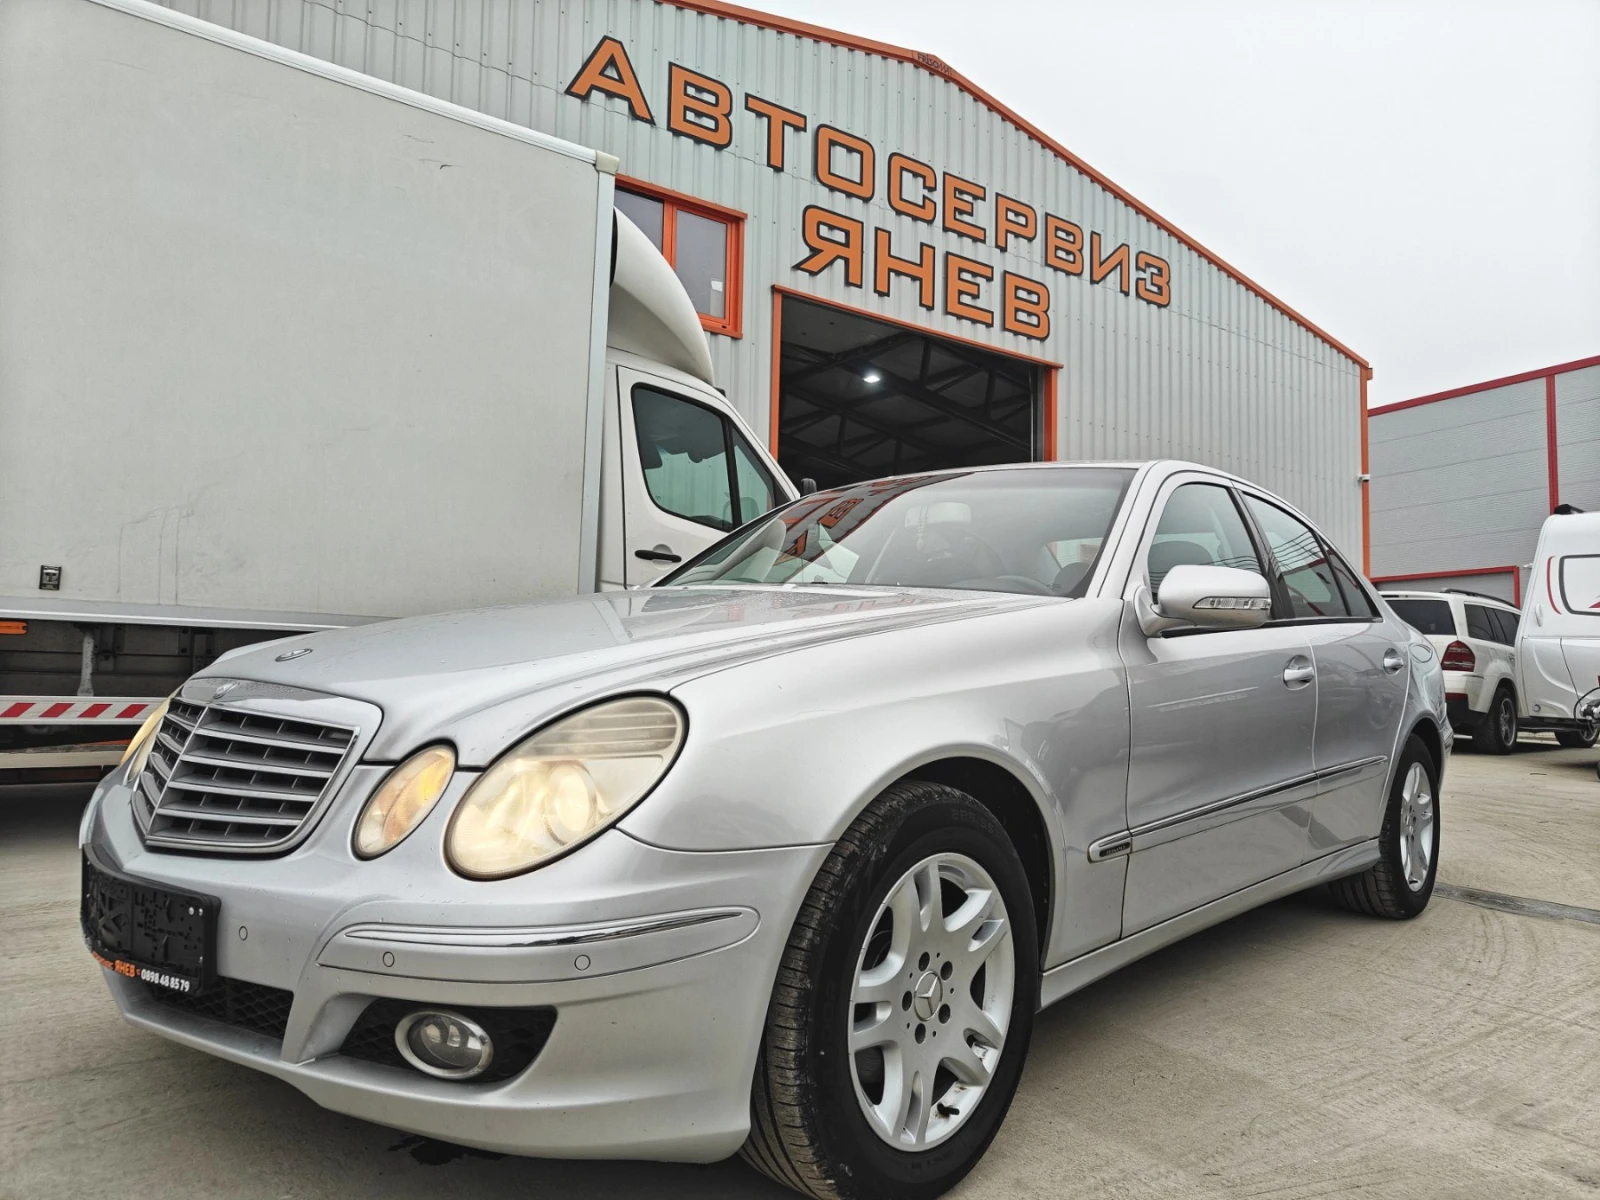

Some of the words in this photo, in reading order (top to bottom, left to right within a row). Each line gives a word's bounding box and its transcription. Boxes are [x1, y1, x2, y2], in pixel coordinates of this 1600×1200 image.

[565, 35, 1171, 308] АВТОСЕРВИЗ
[793, 205, 1050, 341] ЯНЕВ
[115, 960, 135, 978] ЯНЕВ
[141, 969, 159, 984] 0898
[160, 974, 170, 987] 48
[170, 976, 180, 990] 85
[180, 979, 190, 992] 79
